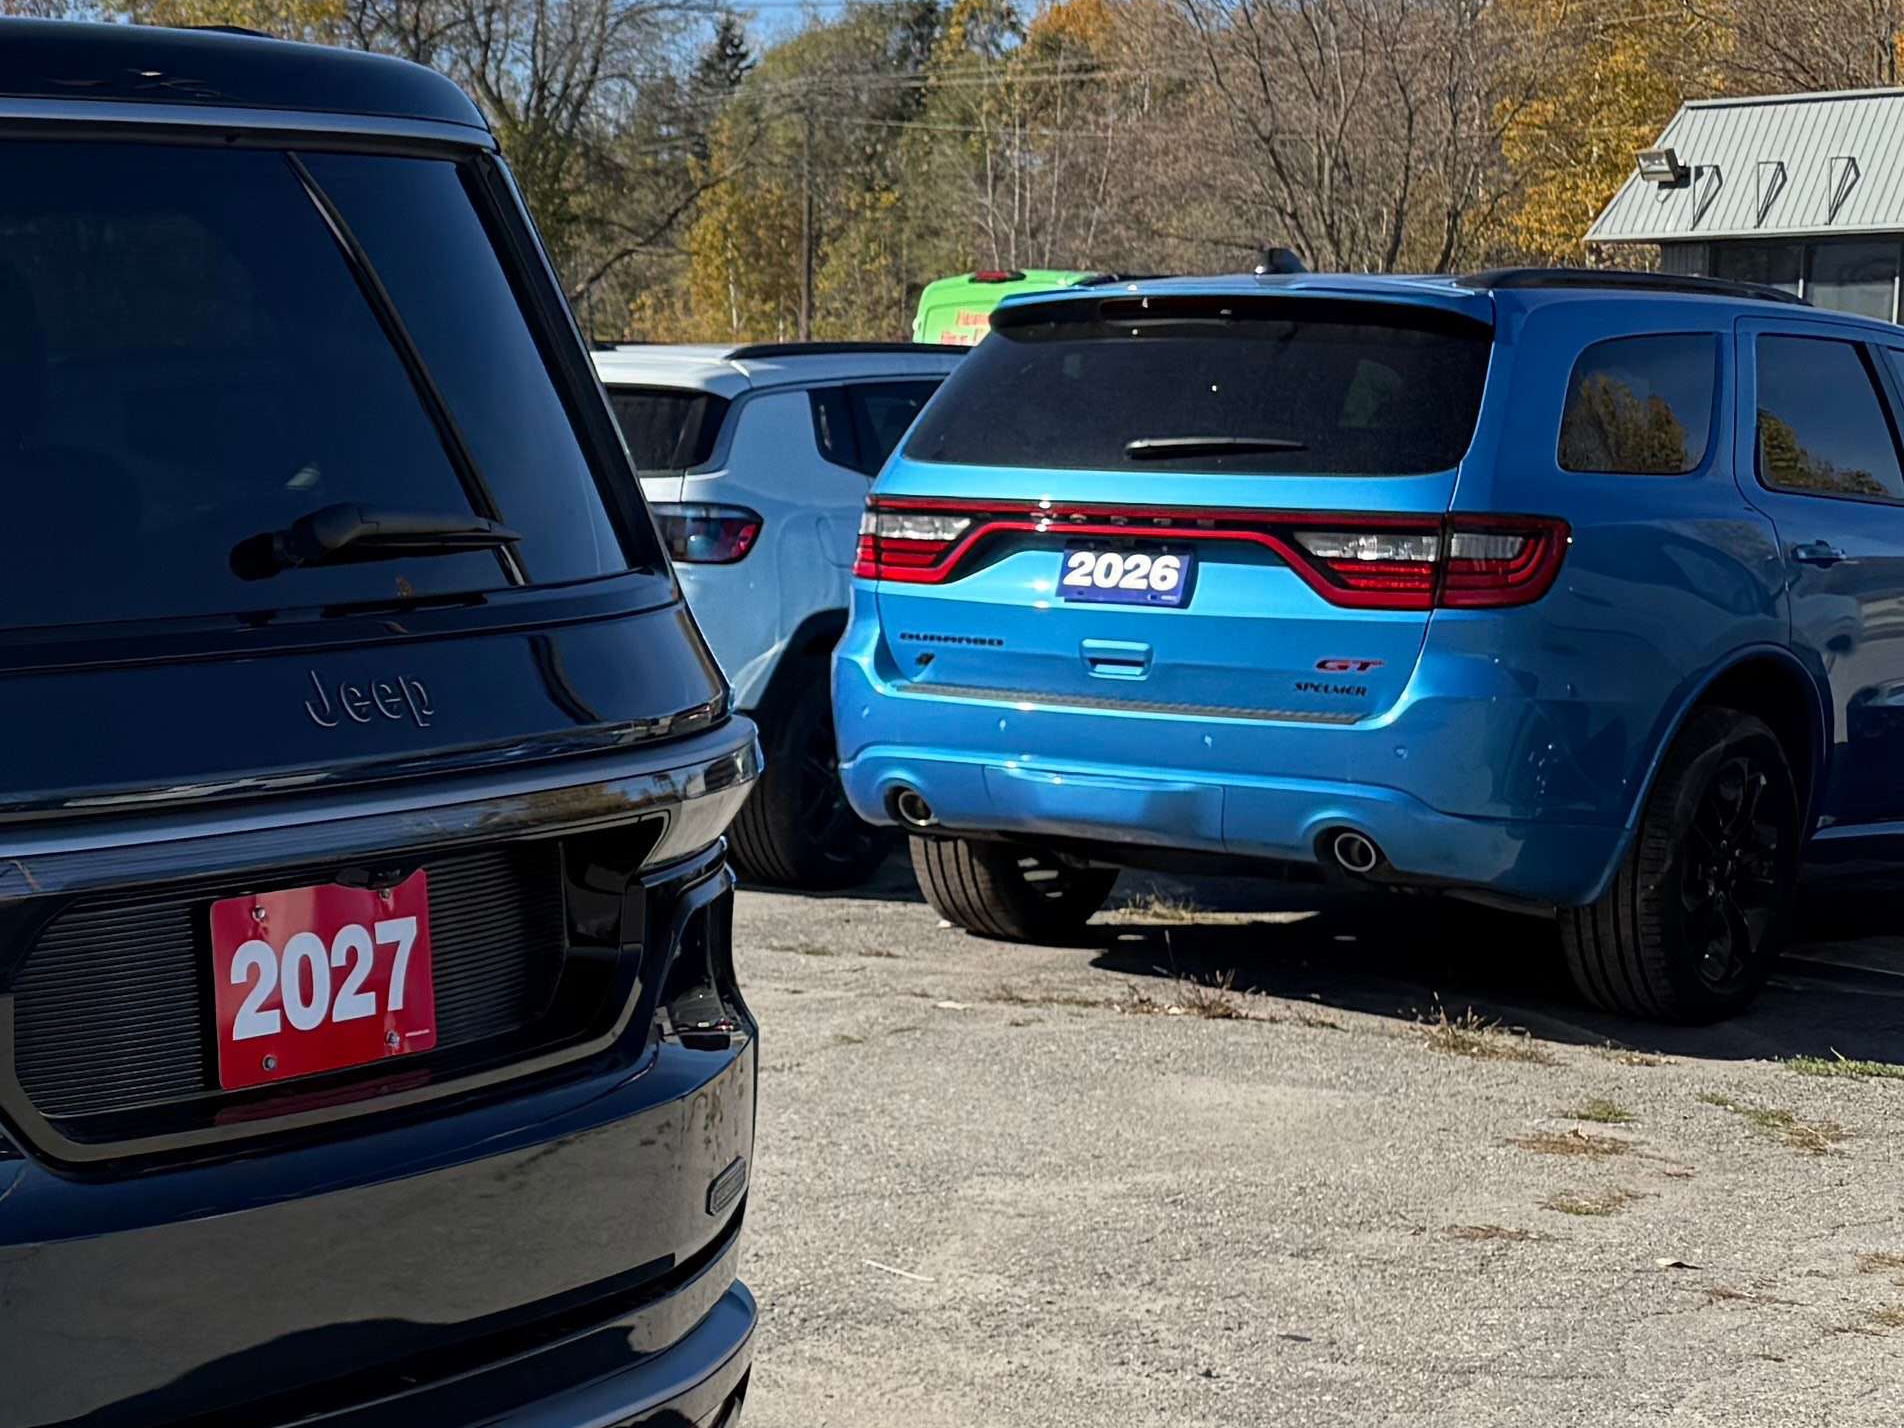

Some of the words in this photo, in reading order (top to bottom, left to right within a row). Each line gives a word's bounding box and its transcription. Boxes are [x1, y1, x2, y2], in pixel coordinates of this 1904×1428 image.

[1062, 551, 1181, 592] 2026
[1315, 659, 1385, 672] GT
[304, 669, 435, 728] Jeep
[229, 916, 418, 1041] 2027
